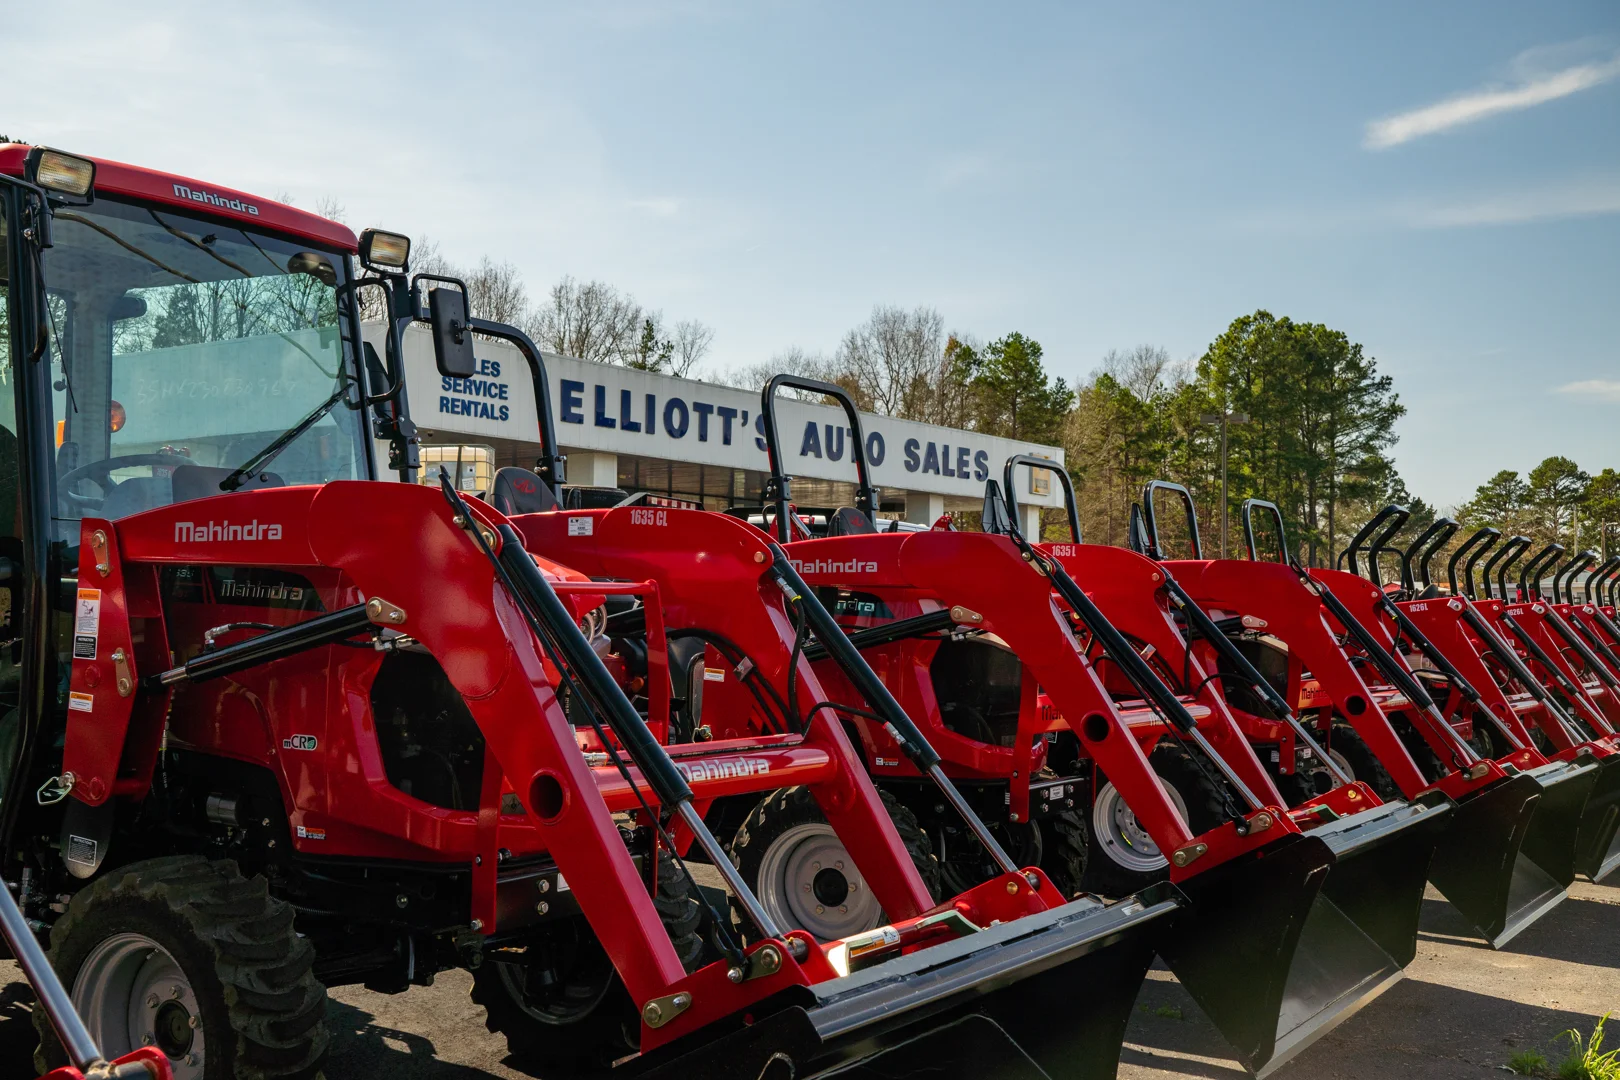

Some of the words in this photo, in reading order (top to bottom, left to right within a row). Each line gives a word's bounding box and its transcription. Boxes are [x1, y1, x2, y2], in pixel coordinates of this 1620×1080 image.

[172, 183, 260, 216] Mahindra
[441, 375, 509, 400] SERVICE
[439, 395, 510, 422] RENTALS
[904, 438, 989, 482] SALES
[630, 509, 655, 526] 1635
[655, 509, 668, 527] CL
[174, 519, 283, 543] Mahindra
[1052, 545, 1072, 557] 1635
[1072, 545, 1077, 557] L
[789, 558, 878, 574] Mahindra
[221, 579, 304, 601] Mahindra
[676, 757, 770, 782] Mahindra
